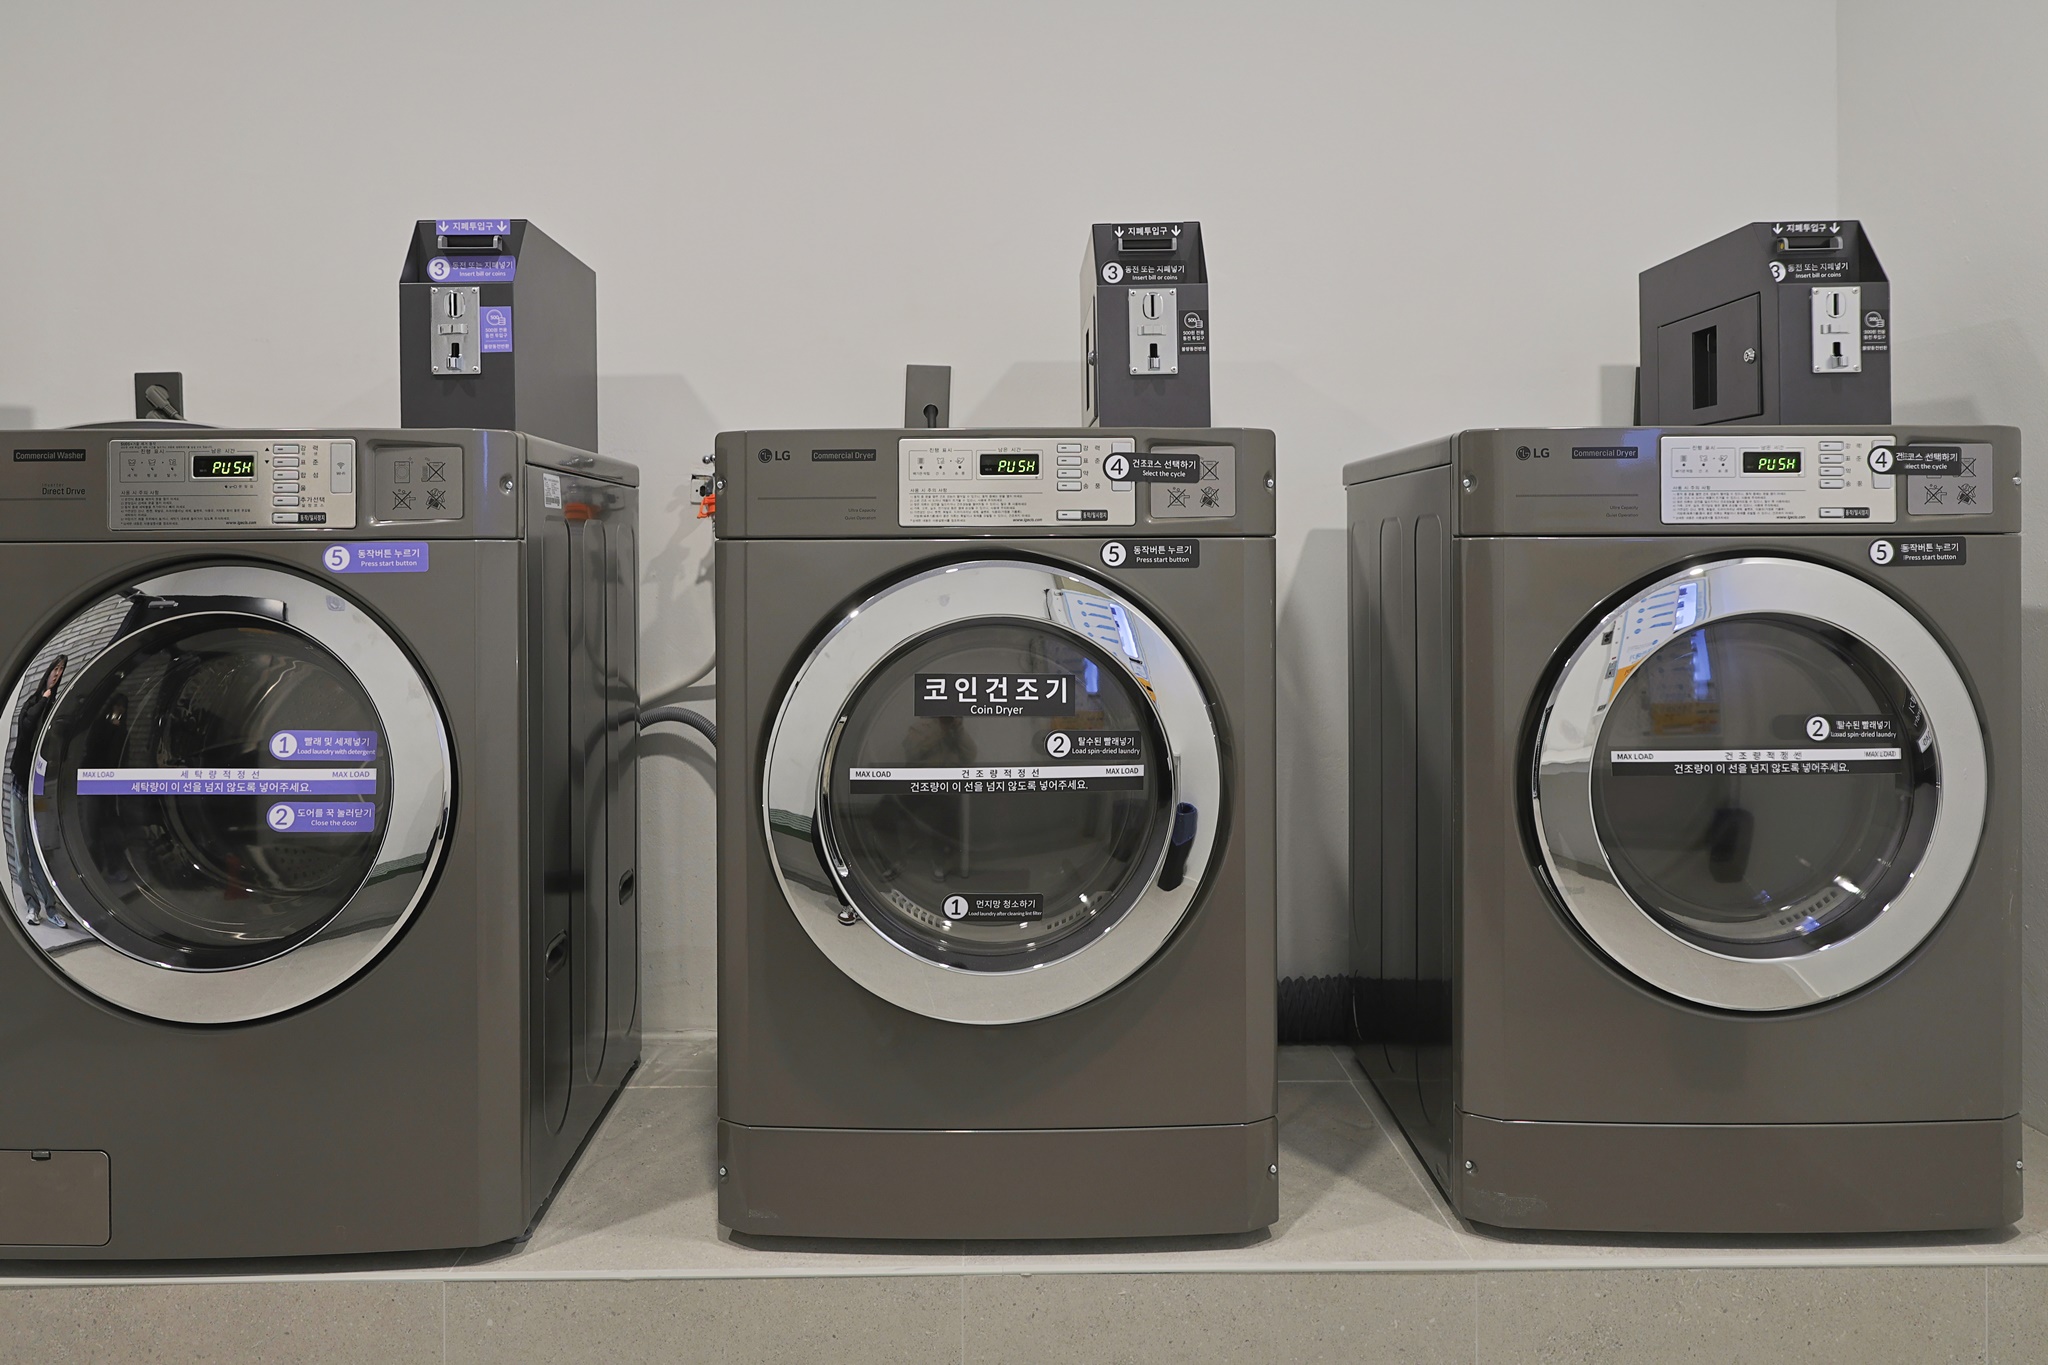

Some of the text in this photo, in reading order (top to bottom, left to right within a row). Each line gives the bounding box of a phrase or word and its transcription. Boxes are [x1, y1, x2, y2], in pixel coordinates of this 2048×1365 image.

[452, 222, 493, 230] 지폐투입구
[1128, 226, 1167, 236] 지폐투입구
[1786, 223, 1827, 232] 지폐투입구
[434, 262, 444, 276] 3
[452, 260, 513, 270] 동전 또는 지폐넣기
[1125, 265, 1184, 274] 동전 또는 지폐넣기
[1788, 262, 1848, 272] 동전 또는 지폐넣기
[1107, 266, 1118, 280] 3
[1770, 264, 1780, 278] 3
[775, 450, 790, 460] LG
[854, 452, 874, 460] Dryer
[1534, 448, 1549, 458] LG
[1616, 450, 1636, 458] Dryer
[1925, 453, 1958, 462] 선택하기
[1132, 459, 1196, 469] 건조코스 선택하기
[1758, 458, 1795, 470] PUSH
[1875, 452, 1887, 468] 4
[212, 461, 251, 474] PUSH
[998, 460, 1035, 473] PUSH
[1110, 459, 1123, 475] 4
[1133, 545, 1191, 554] 동작버튼 누르기
[1876, 544, 1886, 560] 5
[1900, 543, 1958, 552] 동작버튼 누르기
[331, 549, 343, 566] 5
[358, 548, 420, 558] 동작버튼 누르기
[1109, 546, 1120, 562] 5
[924, 676, 1067, 703] 코인건조기
[970, 705, 1023, 716] Coin Dryer
[1812, 720, 1823, 736] 2
[1836, 720, 1890, 730] 탈수된 빨래넣기
[279, 737, 289, 753] 1
[304, 737, 370, 747] 빨래 및 세제넣기
[1053, 736, 1064, 753] 2
[1078, 737, 1134, 746] 탈수된 빨래넣기
[348, 749, 375, 757] detergent
[1088, 748, 1117, 756] spin-dried
[1119, 748, 1140, 756] laundry
[1674, 763, 1850, 774] 건조량이 이 선을 넘지 않도록 넣어주세요.
[131, 782, 312, 792] 세탁량이 이 선을 넘지 않도록 넣어주세요.
[910, 780, 1088, 792] 건조량이 이 선을 넘지 않도록 넣어주세요.
[275, 808, 288, 825] 2
[297, 808, 372, 818] 도어를 꾹 눌러닫기
[951, 899, 961, 915] 1
[976, 900, 1036, 908] 먼지망 청소하기
